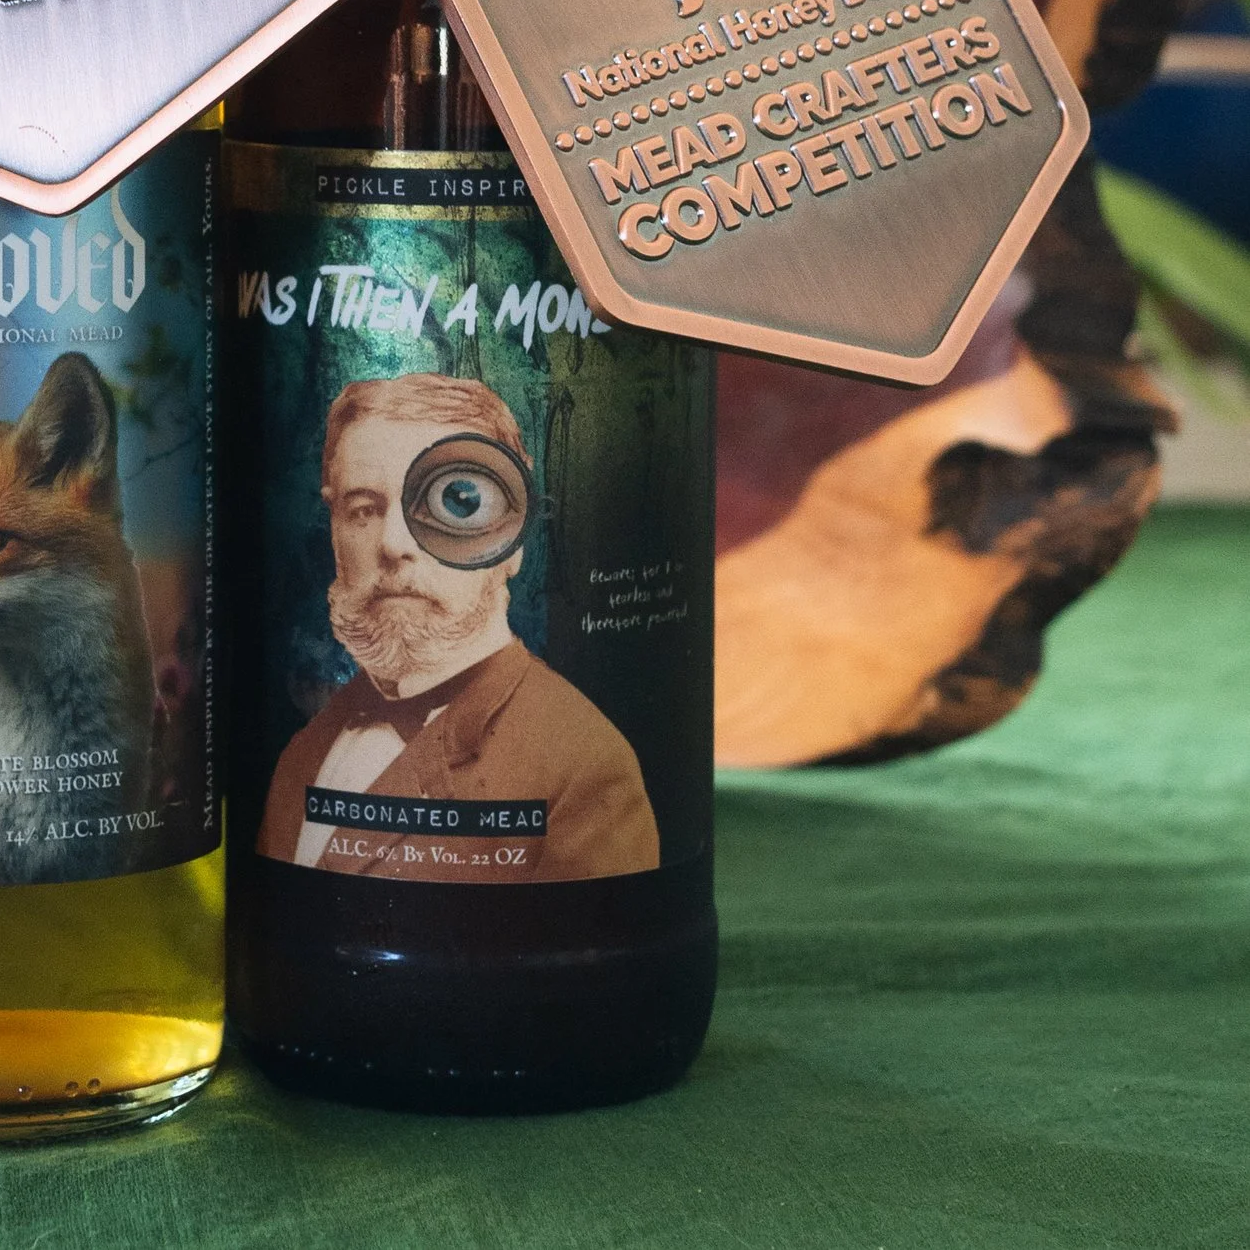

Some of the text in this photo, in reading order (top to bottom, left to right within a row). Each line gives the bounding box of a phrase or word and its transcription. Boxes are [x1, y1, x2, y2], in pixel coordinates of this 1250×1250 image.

[563, 22, 725, 106] National
[589, 17, 1000, 204] MEAD CRAFTERS
[620, 65, 1032, 260] COMPETITION
[317, 176, 531, 198] PICKLE INSPIR
[237, 271, 299, 327] WAS
[319, 264, 440, 340] THEN
[444, 283, 480, 336] A
[69, 325, 124, 343] MEAD
[32, 749, 120, 772] BLOSSOM
[57, 771, 125, 794] HONEY
[4, 810, 165, 846] 14% ALC. BY VOL.
[307, 796, 544, 829] CARBONATED MEAD
[328, 836, 373, 858] ALC.
[471, 853, 491, 866] 22
[495, 847, 527, 865] OZ
